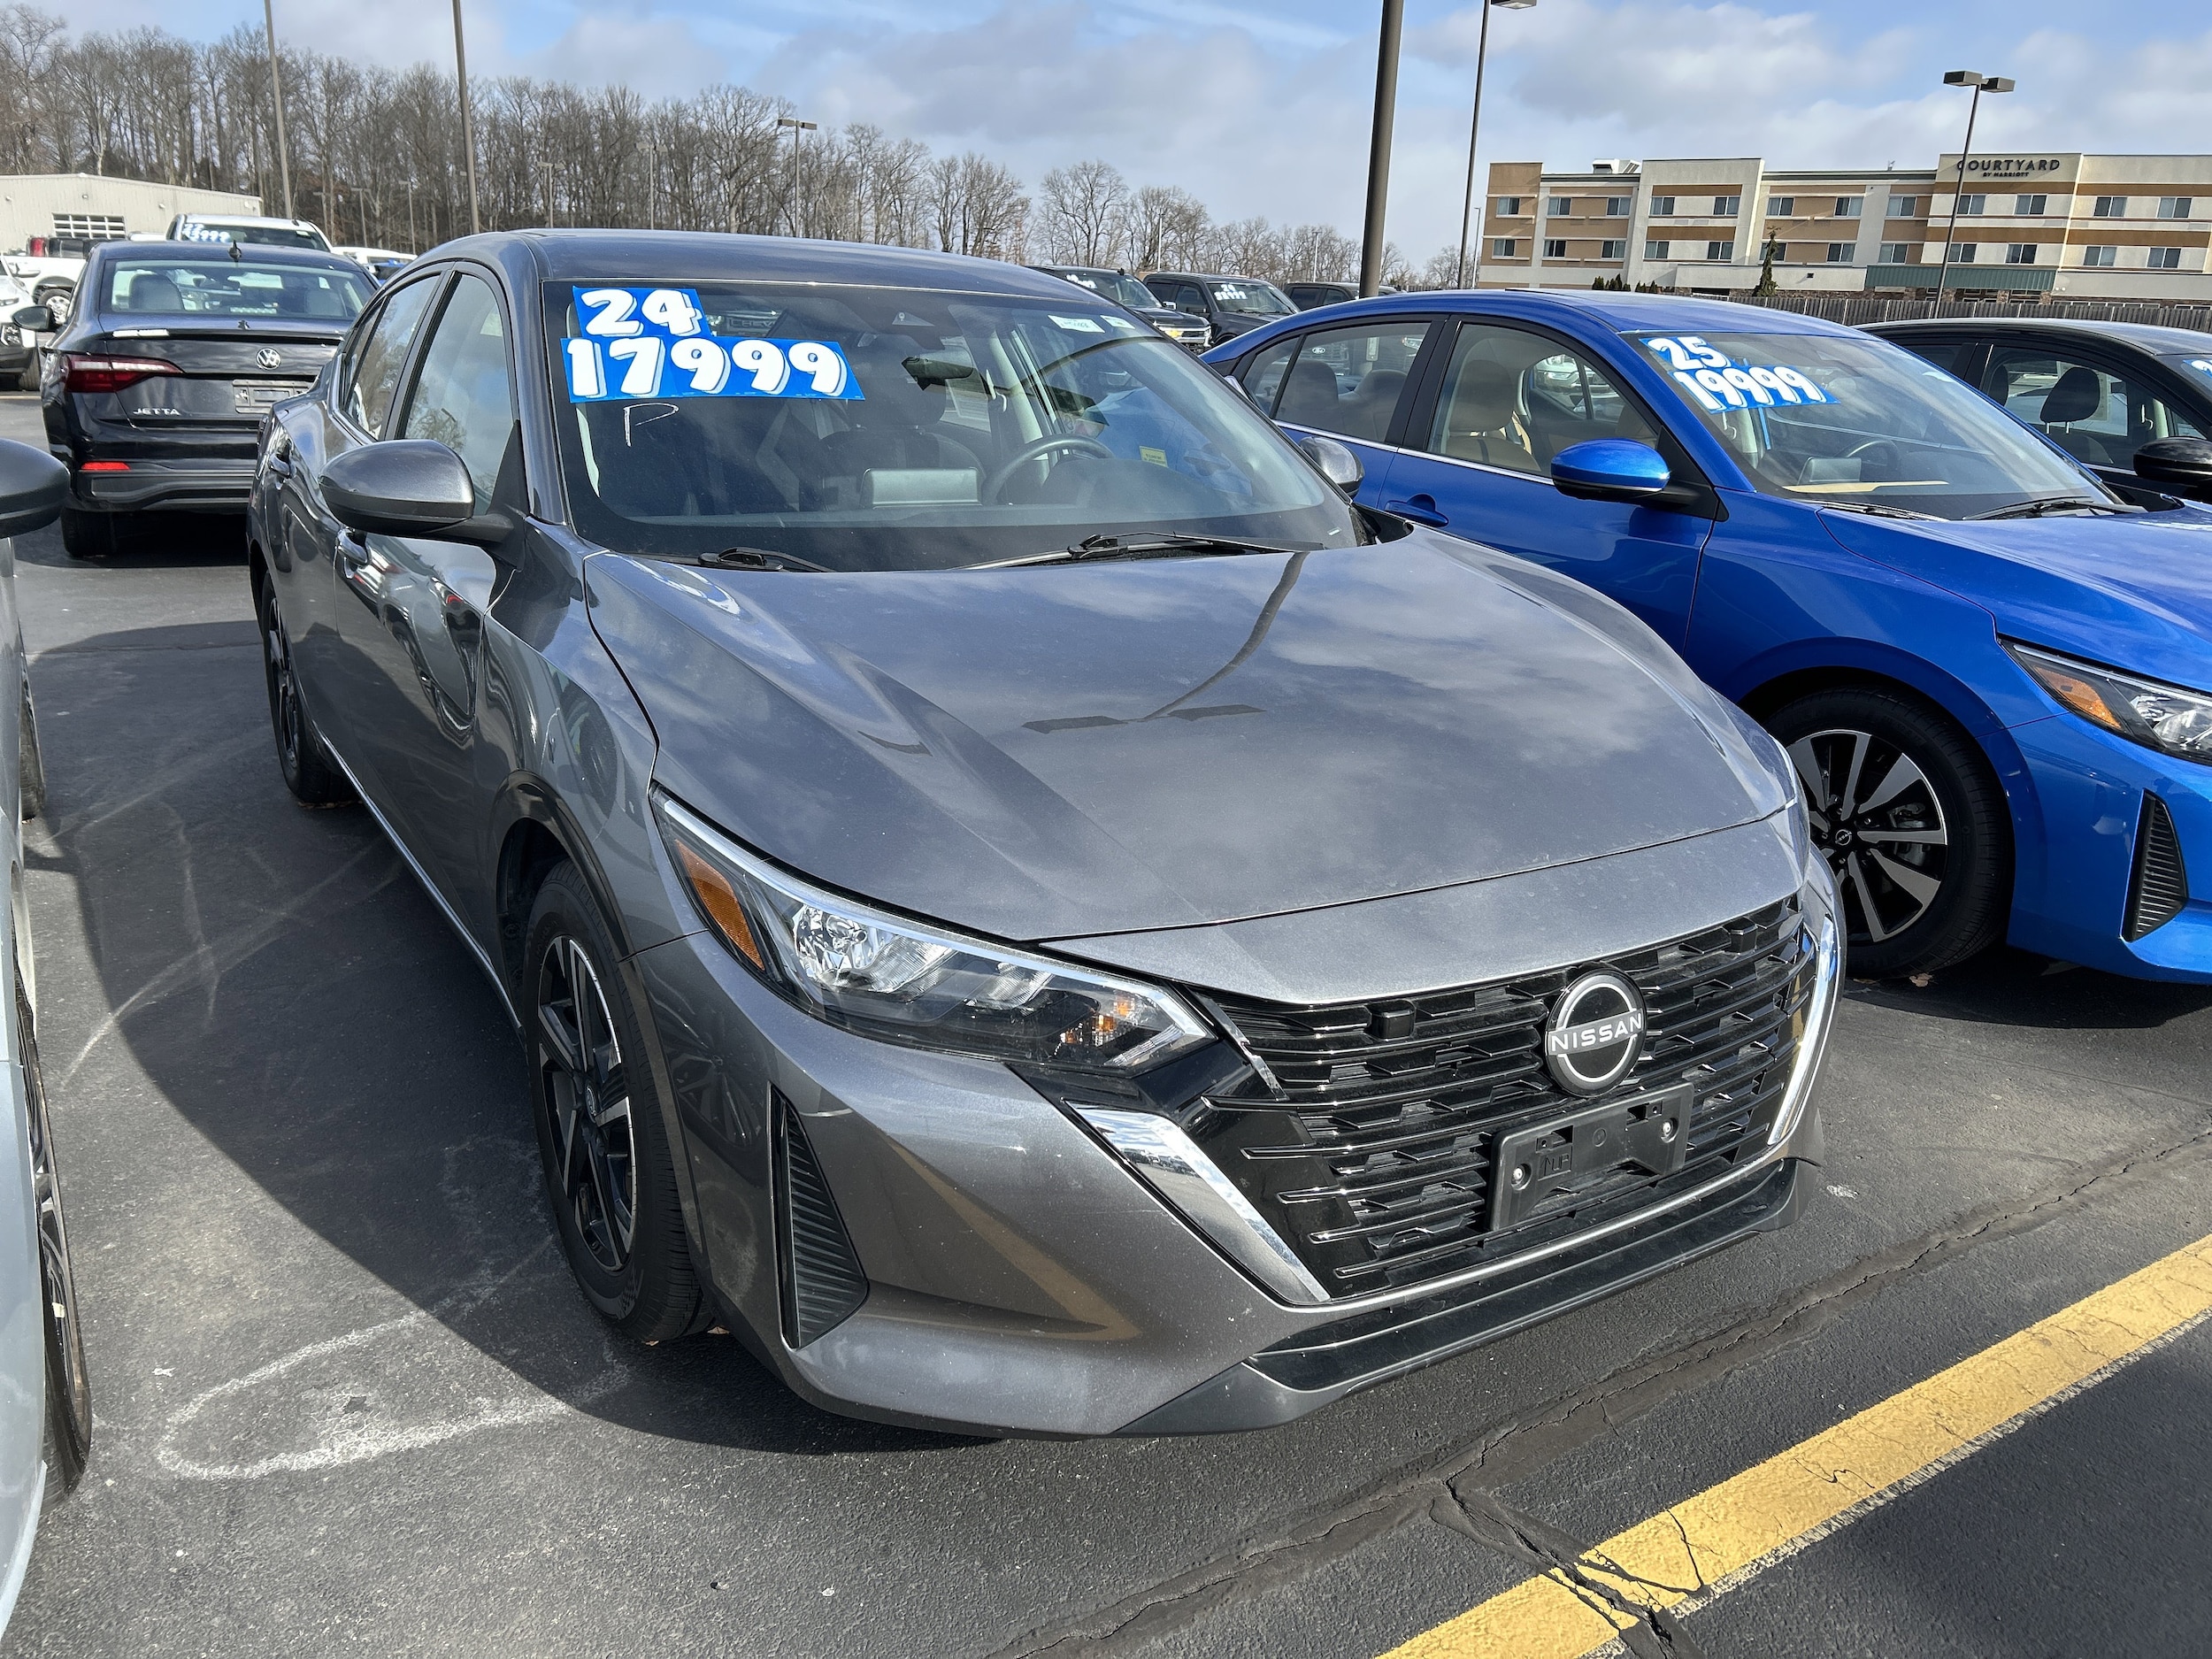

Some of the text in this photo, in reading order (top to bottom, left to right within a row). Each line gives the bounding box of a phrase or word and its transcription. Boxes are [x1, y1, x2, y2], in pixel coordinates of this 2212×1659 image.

[1956, 159, 2060, 171] COURTYARD
[580, 289, 703, 337] 24
[566, 337, 848, 398] 17999
[1647, 336, 1732, 370] 25
[1673, 366, 1826, 411] 19999
[133, 407, 181, 416] JETTA
[1551, 1013, 1642, 1052] NISSAN
